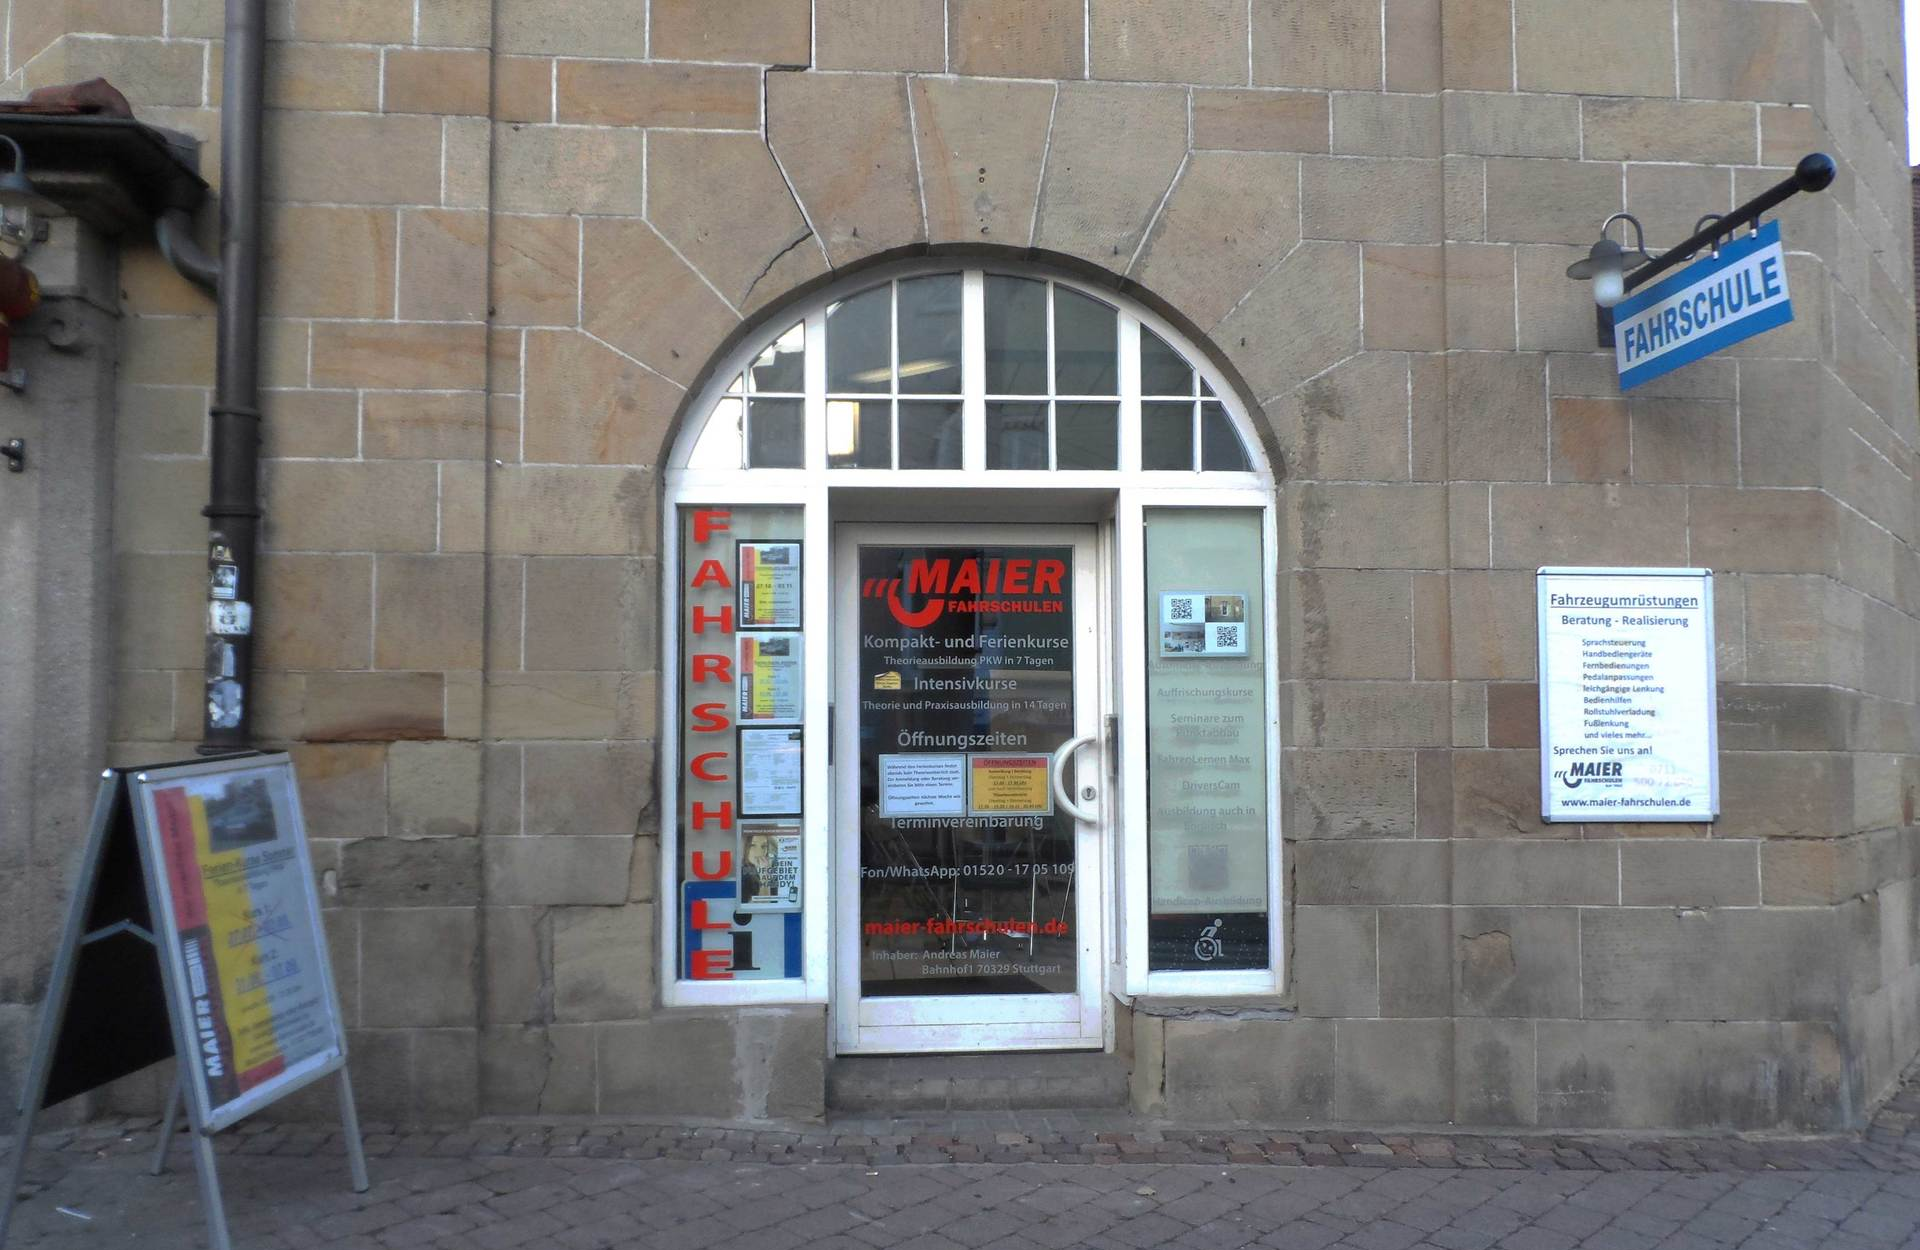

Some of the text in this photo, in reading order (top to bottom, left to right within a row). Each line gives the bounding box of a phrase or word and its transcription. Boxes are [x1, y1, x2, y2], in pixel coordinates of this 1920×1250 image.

[1624, 256, 1782, 362] FAHRSCHULE
[908, 559, 1065, 594] MAIER
[1551, 594, 1698, 608] Fahrzeugumrüstungen
[948, 601, 1064, 613] FAHRSCHULEN
[1562, 615, 1611, 627] Beratung
[1622, 616, 1688, 627] Realisierung
[864, 635, 1069, 651] Kompakt- und Ferienkurse
[1582, 639, 1646, 647] Sprachsteuerung
[1583, 650, 1652, 659] Handbediengeräte
[884, 656, 1054, 667] Theorieausbildung PKW in 7 Tagen
[1583, 662, 1649, 670] Fernbedienungen
[914, 677, 1017, 690] Intensivkurse
[1583, 674, 1654, 682] Pedalanpassungen
[1157, 688, 1253, 698] Auffrischungskurse
[1633, 685, 1664, 694] Lenkung
[863, 701, 1067, 711] Theorie und Praxisausbildung in 14 Tagen
[1170, 713, 1244, 723] Seminare zum
[1584, 708, 1655, 717] Rollstuhlverladung
[1584, 720, 1629, 728] Fußlenkung
[897, 729, 1027, 749] Öffnungszeiten
[1585, 731, 1599, 739] und
[1600, 731, 1623, 739] vieles
[690, 511, 734, 979] FAHRSCHULE
[1553, 746, 1653, 756] Sprechen Sie uns an!
[1230, 755, 1250, 764] Max
[1570, 762, 1622, 777] MAIER
[1182, 780, 1240, 790] DriversCam
[1561, 798, 1691, 807] www.maier-fahrschulen.de
[1158, 806, 1255, 818] Ausbildung auch in
[892, 815, 1044, 830] Terminvereinbarung
[861, 864, 960, 879] Fon/WhatsApp:
[963, 864, 1004, 876] 01520
[1015, 864, 1028, 875] 17
[1034, 863, 1048, 875] 05
[1052, 863, 1075, 875] 109
[864, 917, 1068, 935] maier-fahrschulen.de
[872, 950, 1000, 960] Inhaber: Andreas Maier
[922, 964, 1061, 976] Bahnhof1 70329 Stuttgart
[195, 999, 224, 1077] MAIER
